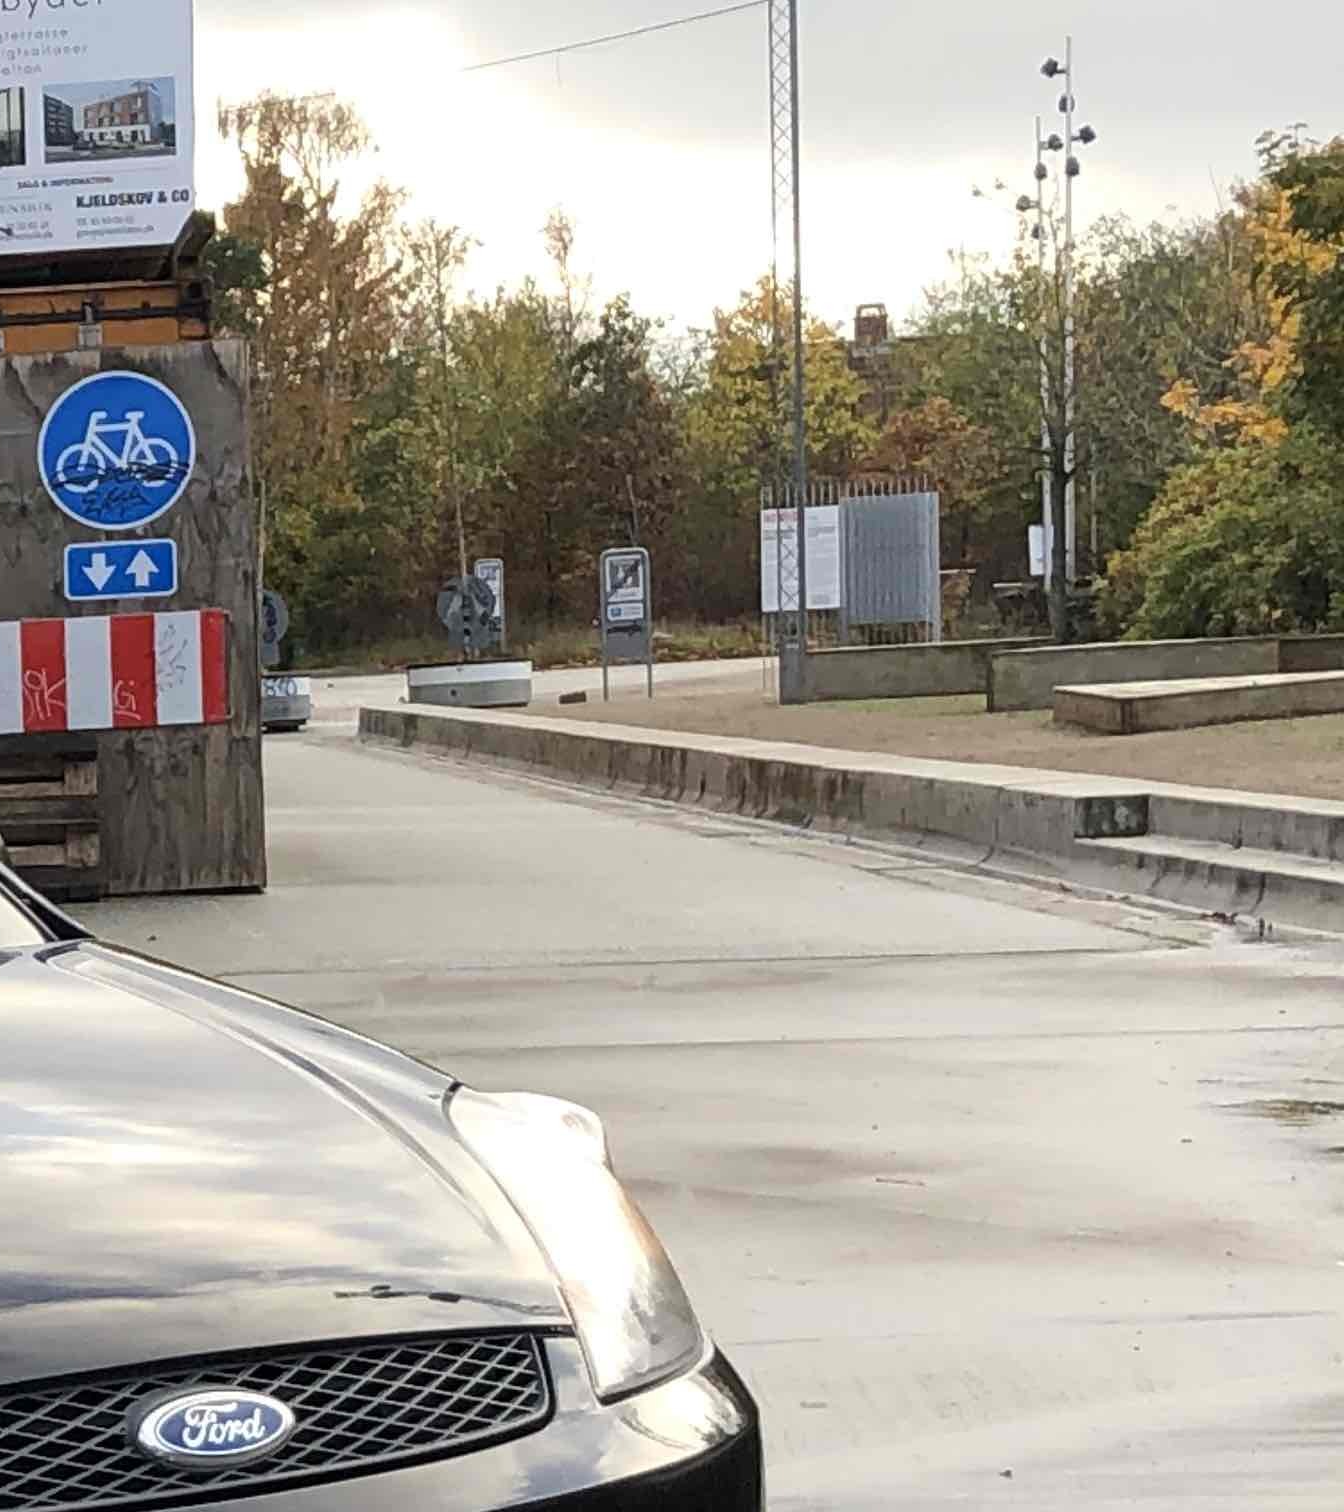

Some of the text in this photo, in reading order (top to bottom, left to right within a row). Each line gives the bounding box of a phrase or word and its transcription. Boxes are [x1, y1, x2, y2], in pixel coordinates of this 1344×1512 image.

[76, 190, 153, 209] KJELDSKOV
[171, 188, 190, 202] CO
[181, 1402, 266, 1446] Ford
